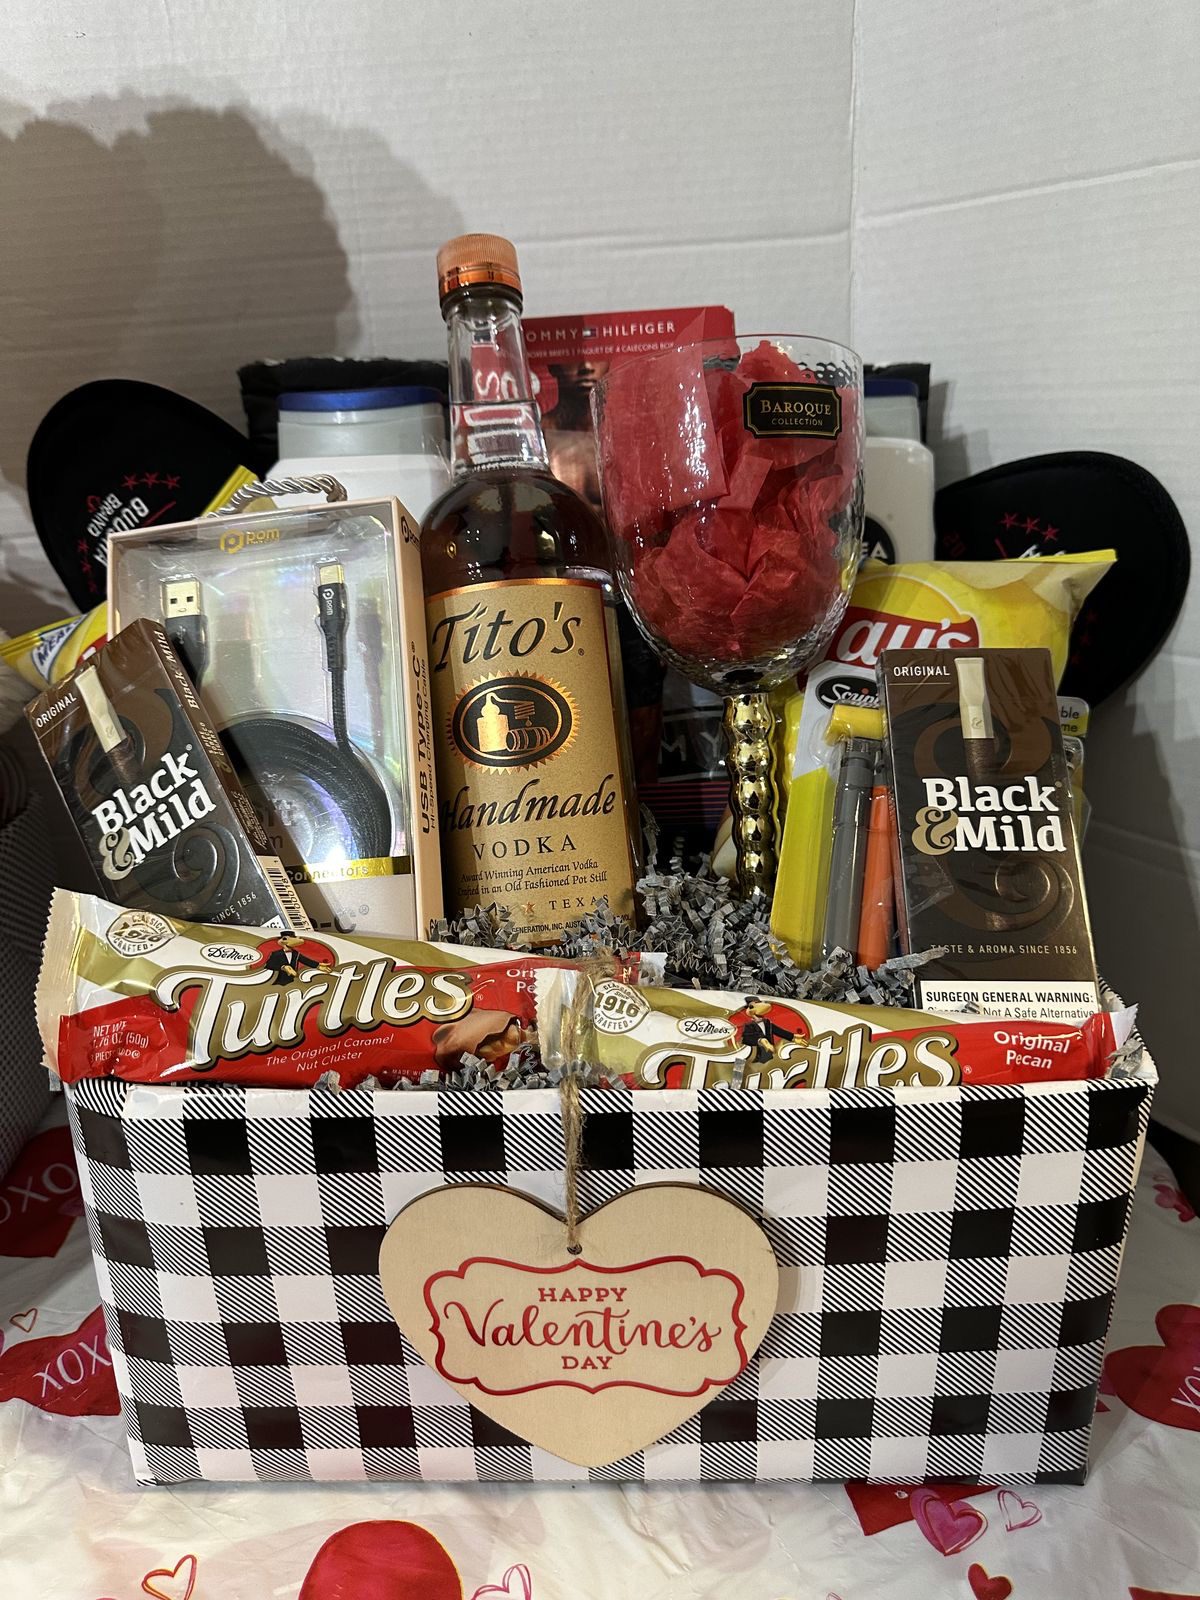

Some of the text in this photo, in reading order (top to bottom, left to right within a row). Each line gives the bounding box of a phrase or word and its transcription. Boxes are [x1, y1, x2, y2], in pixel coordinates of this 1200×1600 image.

[526, 321, 675, 342] OMMY HILFIGER
[760, 400, 832, 417] BAROQUE
[771, 418, 823, 426] COLLECTION
[87, 493, 123, 537] BRAND
[154, 630, 177, 669] Mild
[432, 601, 582, 673] Tito's
[837, 618, 972, 665] ay's
[893, 666, 950, 677] ORIGINAL
[177, 670, 200, 710] Black
[35, 692, 77, 729] ORIGINAL
[412, 654, 431, 834] USB Type-C
[424, 702, 432, 761] Charging
[92, 750, 198, 835] Black
[442, 773, 617, 834] Handmade
[922, 776, 1059, 812] Black
[131, 778, 217, 864] Mild
[953, 815, 1067, 852] Mild
[472, 834, 577, 861] VODKA
[461, 859, 599, 883] Award Winning American Vodka
[481, 885, 490, 894] in
[491, 884, 502, 893] an
[505, 880, 522, 892] Old
[524, 875, 570, 890] Fashioned
[572, 875, 587, 886] Pot
[589, 871, 608, 883] Still
[211, 891, 257, 923] SINCE 1856
[113, 936, 149, 952] CRAFTED
[931, 944, 1077, 954] STE & AROMA SINCE 1856
[594, 991, 640, 1018] 1916
[926, 991, 1094, 1003] SURGEON GENERAL WARNING:
[154, 960, 469, 1066] Turtles
[594, 1013, 628, 1030] CRAFTED
[1004, 1007, 1012, 1018] A
[1014, 1007, 1037, 1019] Safe
[1039, 1007, 1095, 1019] Alternative
[93, 1024, 111, 1037] NET
[126, 1031, 149, 1049] (50g)
[993, 1030, 1072, 1055] Original
[267, 1033, 395, 1067] The Original Caramel
[296, 1051, 363, 1073] Nut Cluster
[1005, 1050, 1053, 1069] Pecan
[538, 1287, 627, 1302] HAPPY
[444, 1298, 722, 1355] Valentine's
[32, 1334, 113, 1398] XOX
[561, 1355, 613, 1370] DAY
